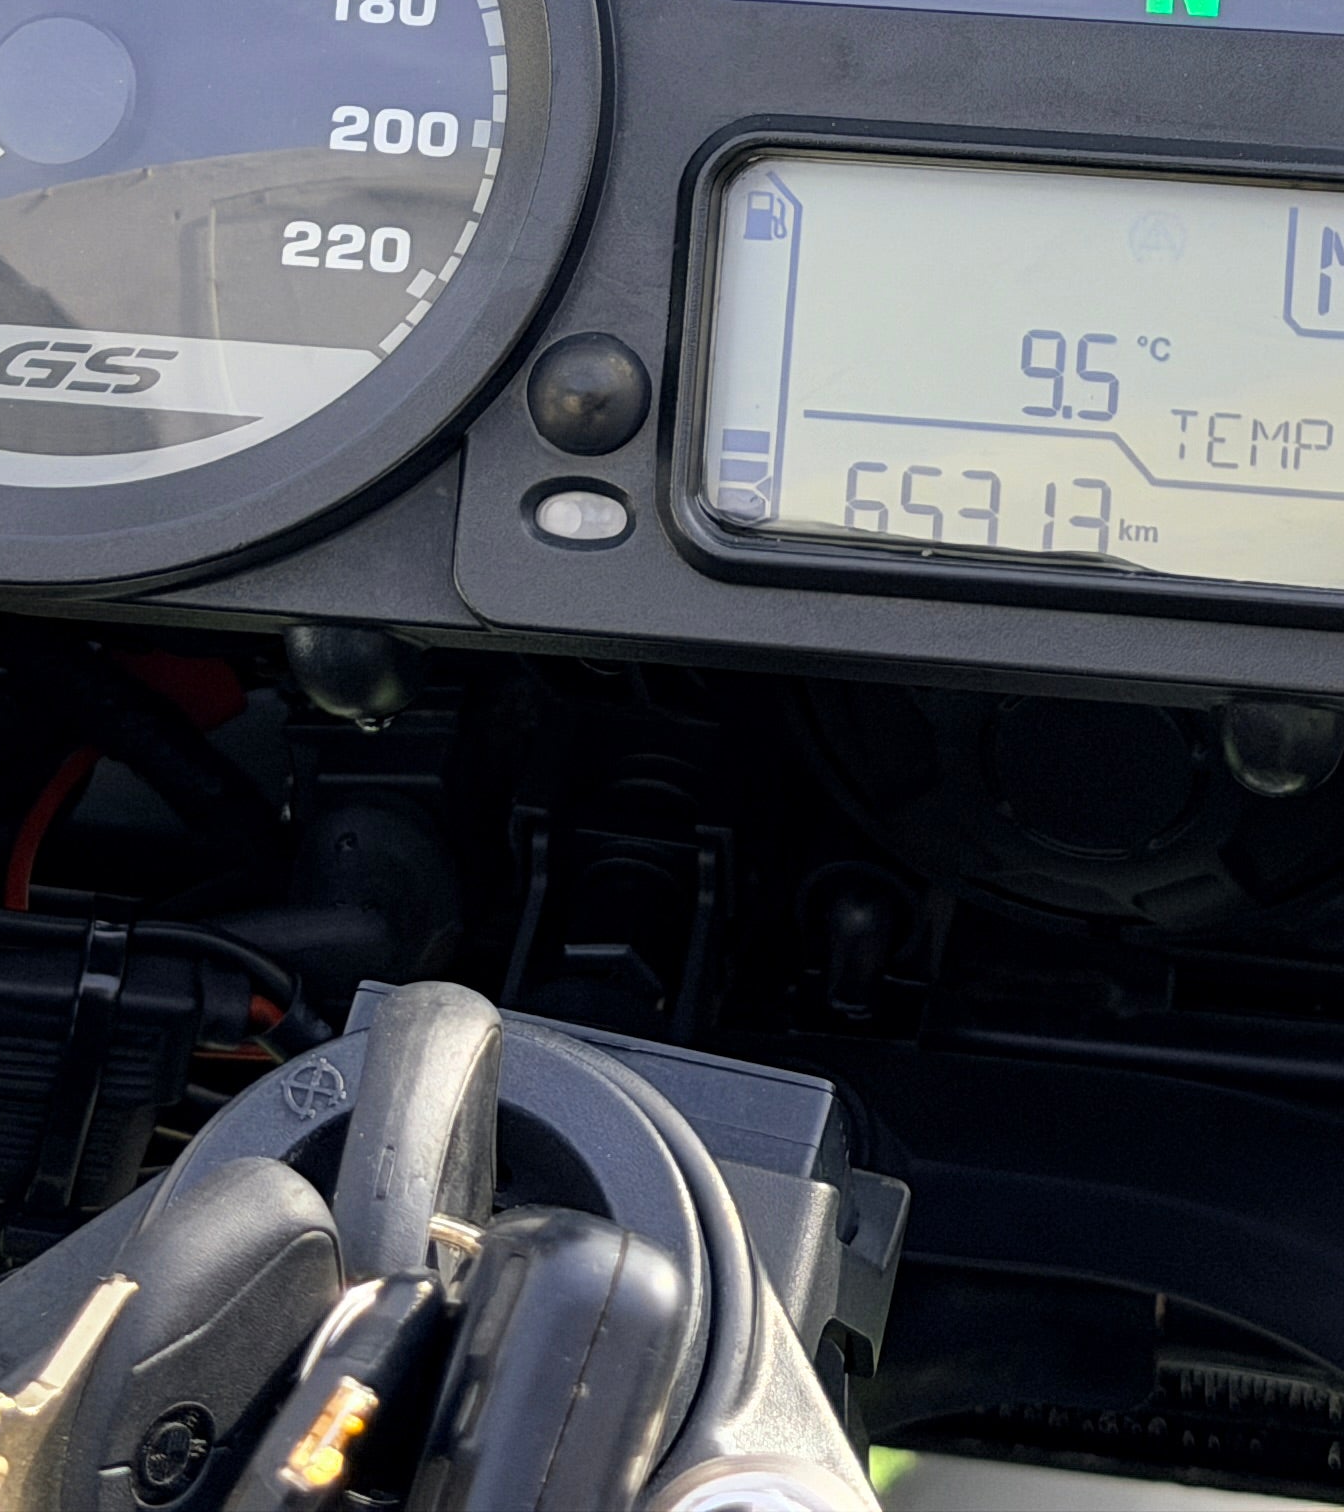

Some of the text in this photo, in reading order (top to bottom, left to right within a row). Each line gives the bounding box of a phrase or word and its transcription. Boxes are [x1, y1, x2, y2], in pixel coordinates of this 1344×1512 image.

[329, 105, 459, 158] 200
[281, 220, 411, 273] 220
[1021, 329, 1172, 422] 9.5 °C
[1170, 408, 1334, 471] TEMP
[844, 461, 1159, 554] 65313 km
